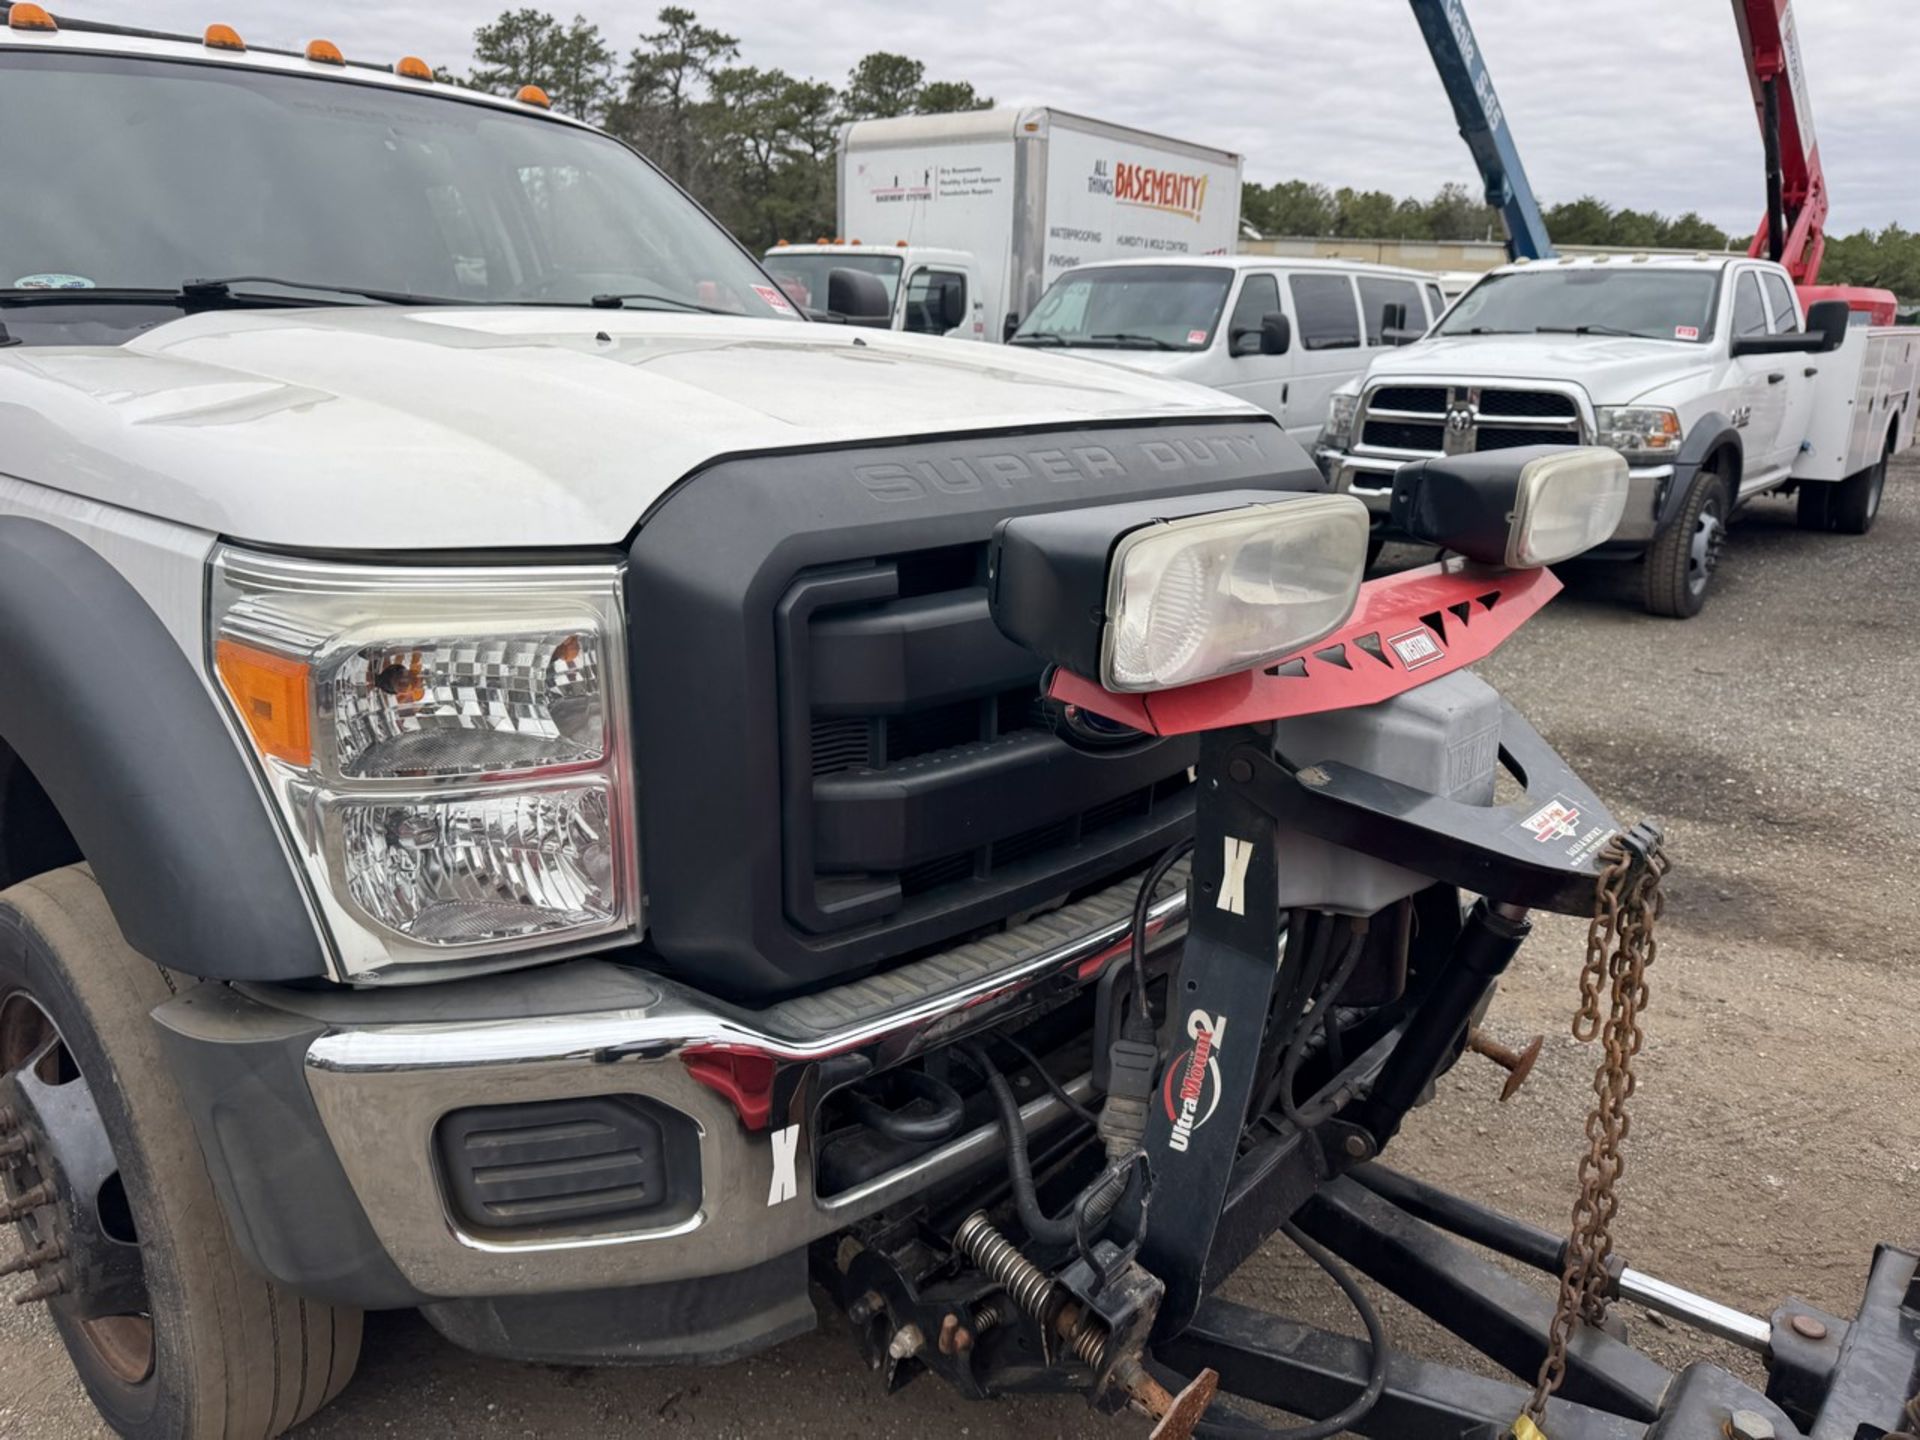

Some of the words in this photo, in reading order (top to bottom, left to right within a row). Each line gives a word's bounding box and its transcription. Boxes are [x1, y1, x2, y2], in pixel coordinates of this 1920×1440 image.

[1094, 160, 1107, 176] ALL
[876, 194, 904, 202] BASEMENT
[1050, 227, 1102, 243] WATERPROOFING
[855, 445, 1128, 502] SUPER
[1138, 434, 1267, 471] DUTY
[1187, 1008, 1227, 1050] 2
